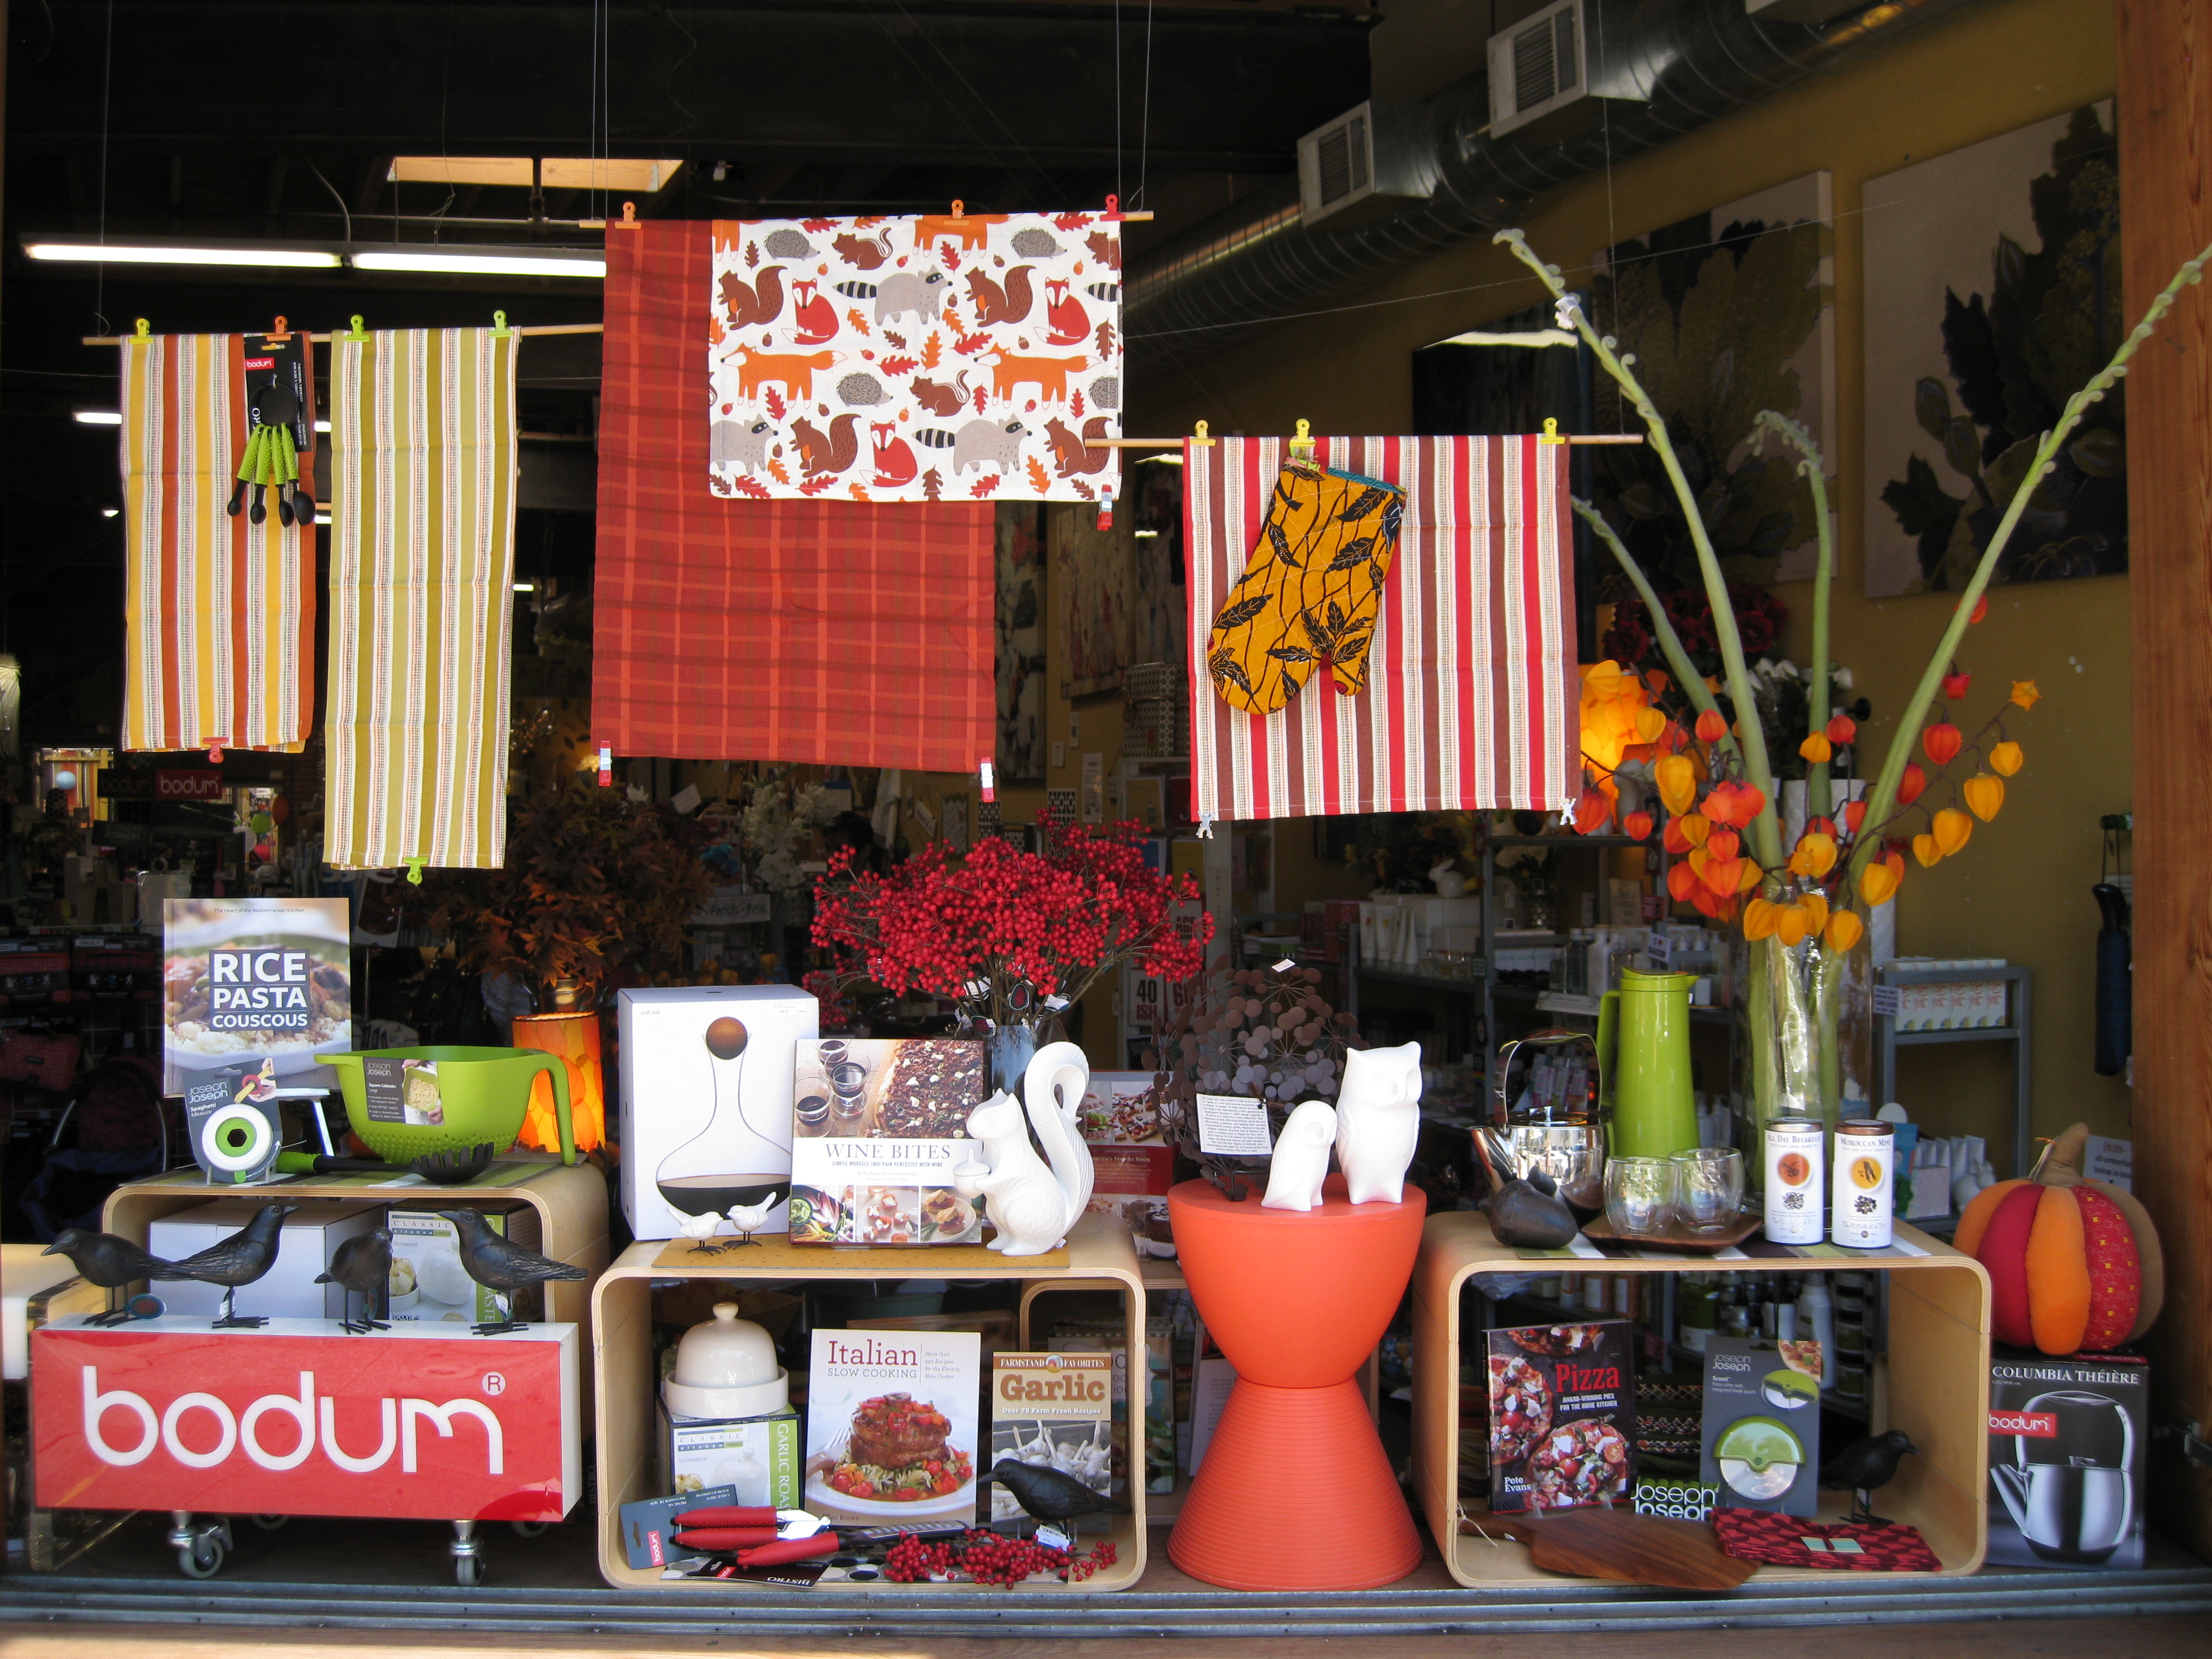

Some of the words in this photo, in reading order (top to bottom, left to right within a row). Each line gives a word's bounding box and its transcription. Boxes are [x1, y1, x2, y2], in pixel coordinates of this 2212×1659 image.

[247, 359, 272, 368] bodum
[160, 775, 219, 794] bodum
[711, 903, 739, 916] Pencils
[746, 903, 765, 915] Pens
[213, 952, 306, 982] RICE
[213, 987, 309, 1009] PASTA
[1137, 979, 1157, 1003] 40
[1136, 1004, 1157, 1020] ISH
[212, 1014, 309, 1028] COUSCOUS
[188, 1081, 228, 1096] Joseph
[189, 1089, 228, 1104] Joseph
[190, 1102, 217, 1112] Spaghetti
[1840, 1137, 1876, 1147] MOROCCAN
[825, 1144, 884, 1159] WINE
[891, 1144, 951, 1159] BITES
[828, 1339, 918, 1365] Italian
[1713, 1354, 1751, 1363] Joseph
[1000, 1358, 1045, 1368] FARMSTAND
[1064, 1359, 1105, 1368] FAVORITES
[1713, 1361, 1750, 1371] Joseph
[827, 1368, 859, 1377] SLOW
[862, 1368, 917, 1378] COOKING
[1555, 1364, 1620, 1393] Pizza
[1991, 1365, 2073, 1381] COLUMBIA
[2074, 1369, 2141, 1384] THÉIÈRE
[1000, 1373, 1105, 1401] Garlic
[1562, 1394, 1603, 1404] AWARD-WINNING
[1603, 1392, 1615, 1401] PIES
[1596, 1400, 1618, 1408] KITCHEN
[84, 1365, 503, 1474] bodum
[1989, 1413, 2048, 1431] bodum
[680, 1433, 742, 1443] CLASSIC
[777, 1423, 790, 1472] GARLIC
[1504, 1477, 1524, 1485] Pete
[1504, 1483, 1531, 1493] Evans
[1630, 1483, 1716, 1505] Joseph
[649, 1533, 662, 1563] bodum
[766, 1576, 812, 1586] BISTRO
